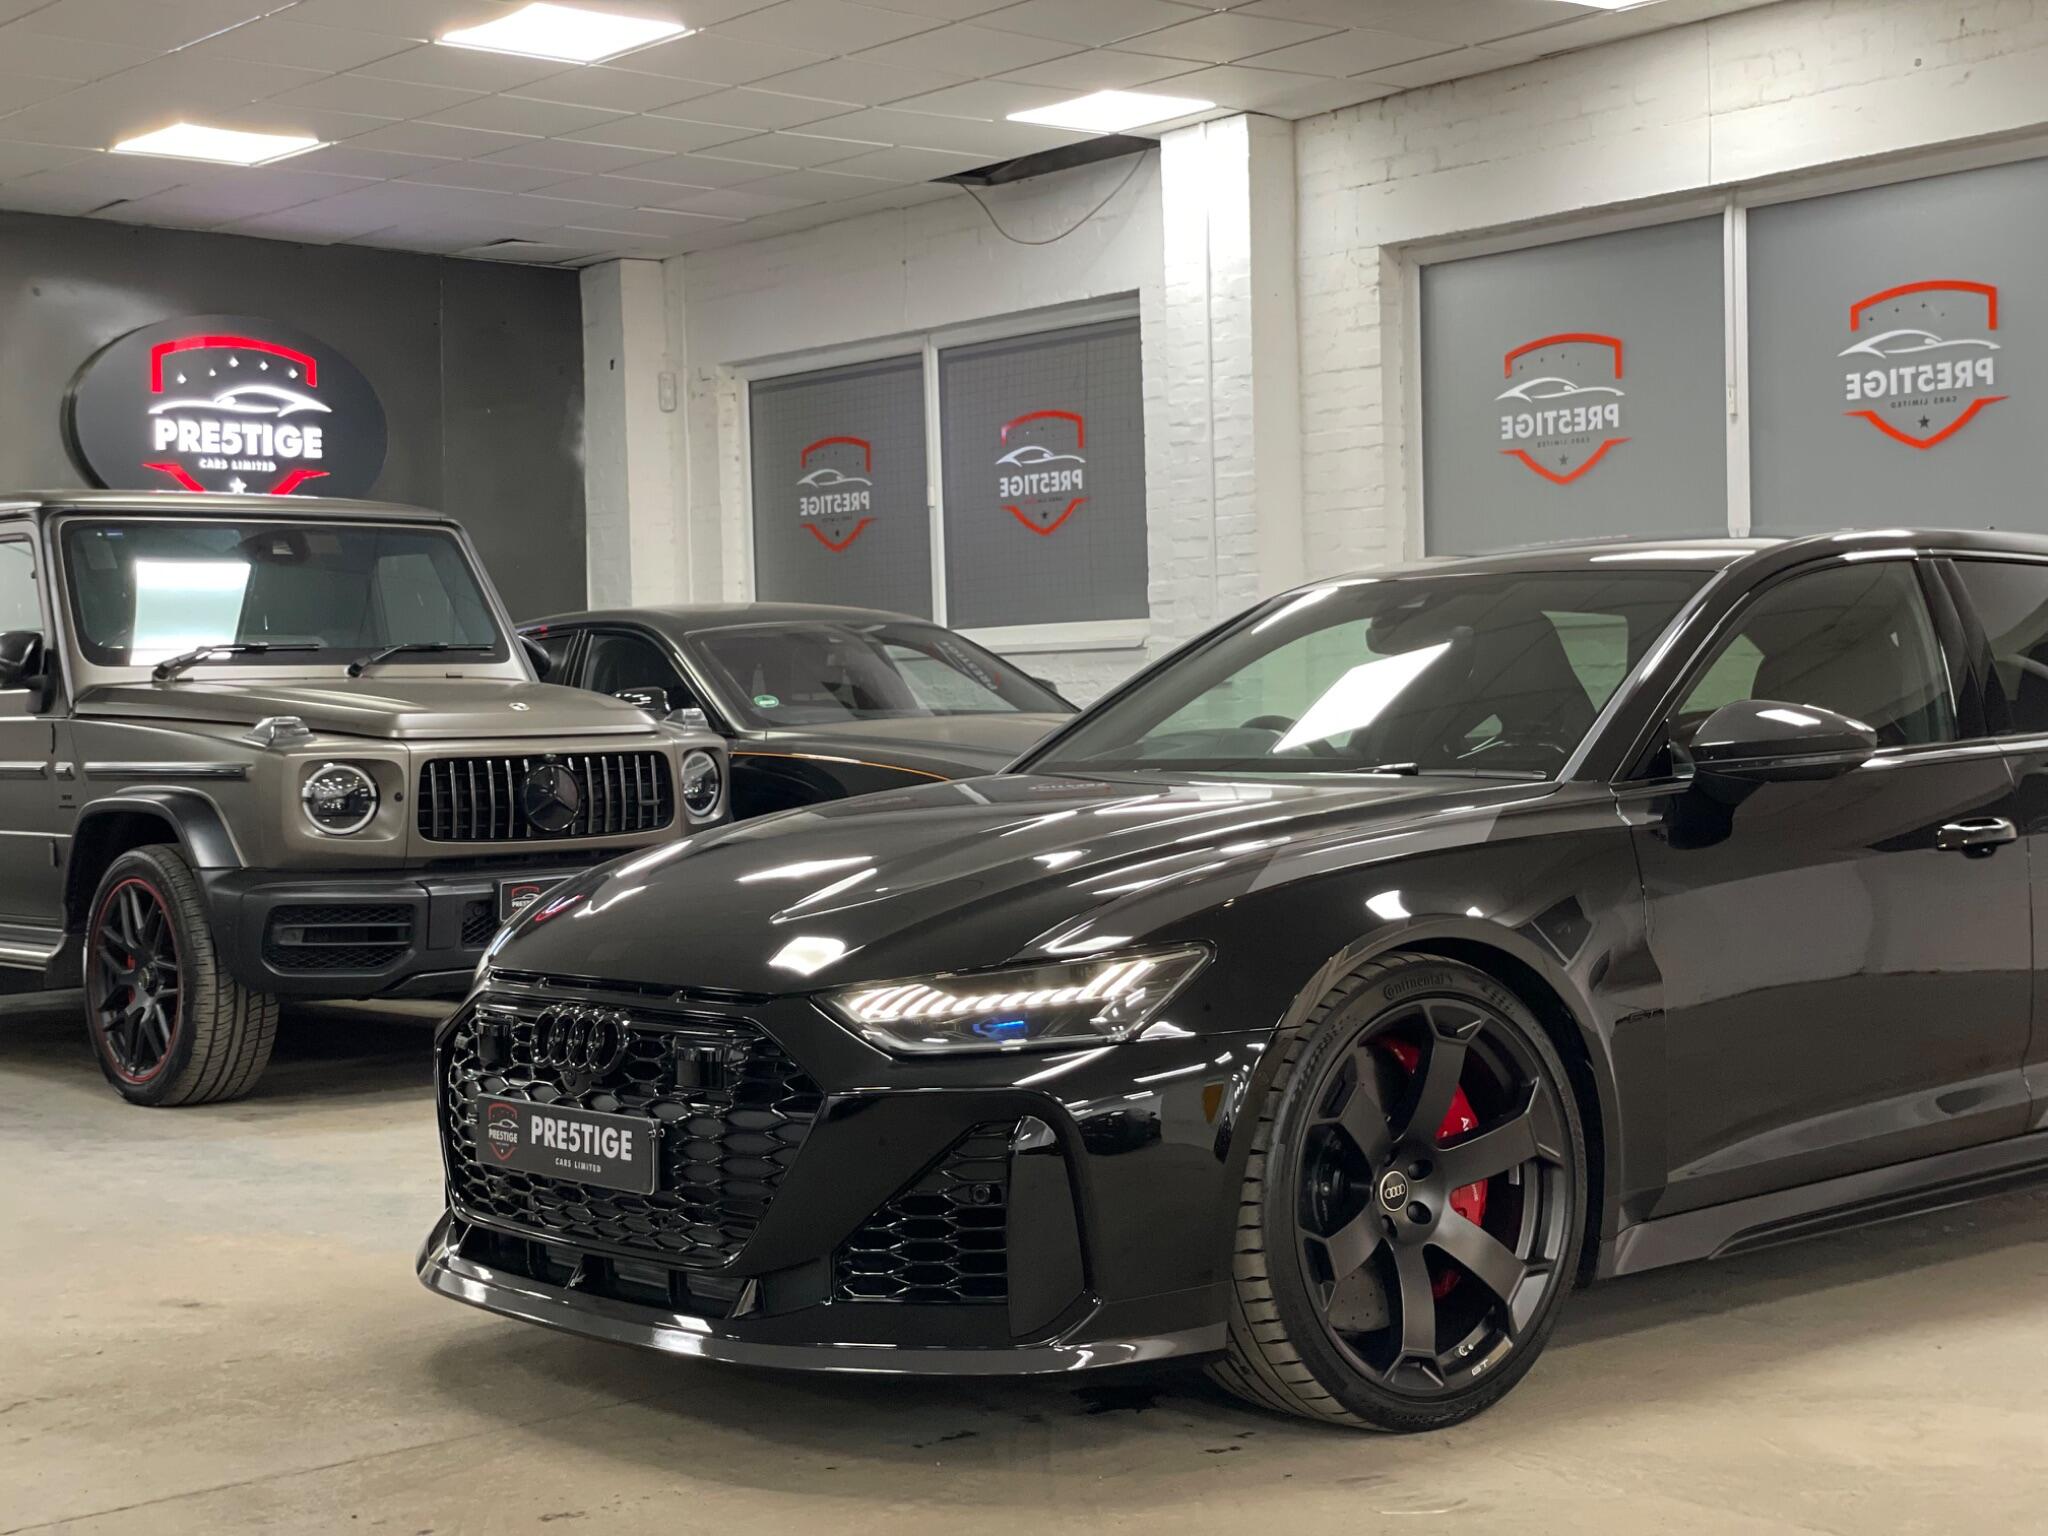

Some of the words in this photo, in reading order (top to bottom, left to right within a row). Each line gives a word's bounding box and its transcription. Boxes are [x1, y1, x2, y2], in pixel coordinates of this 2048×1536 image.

[231, 460, 277, 472] LIMITED
[555, 1157, 572, 1168] CARS
[574, 1160, 602, 1173] LIMITED
